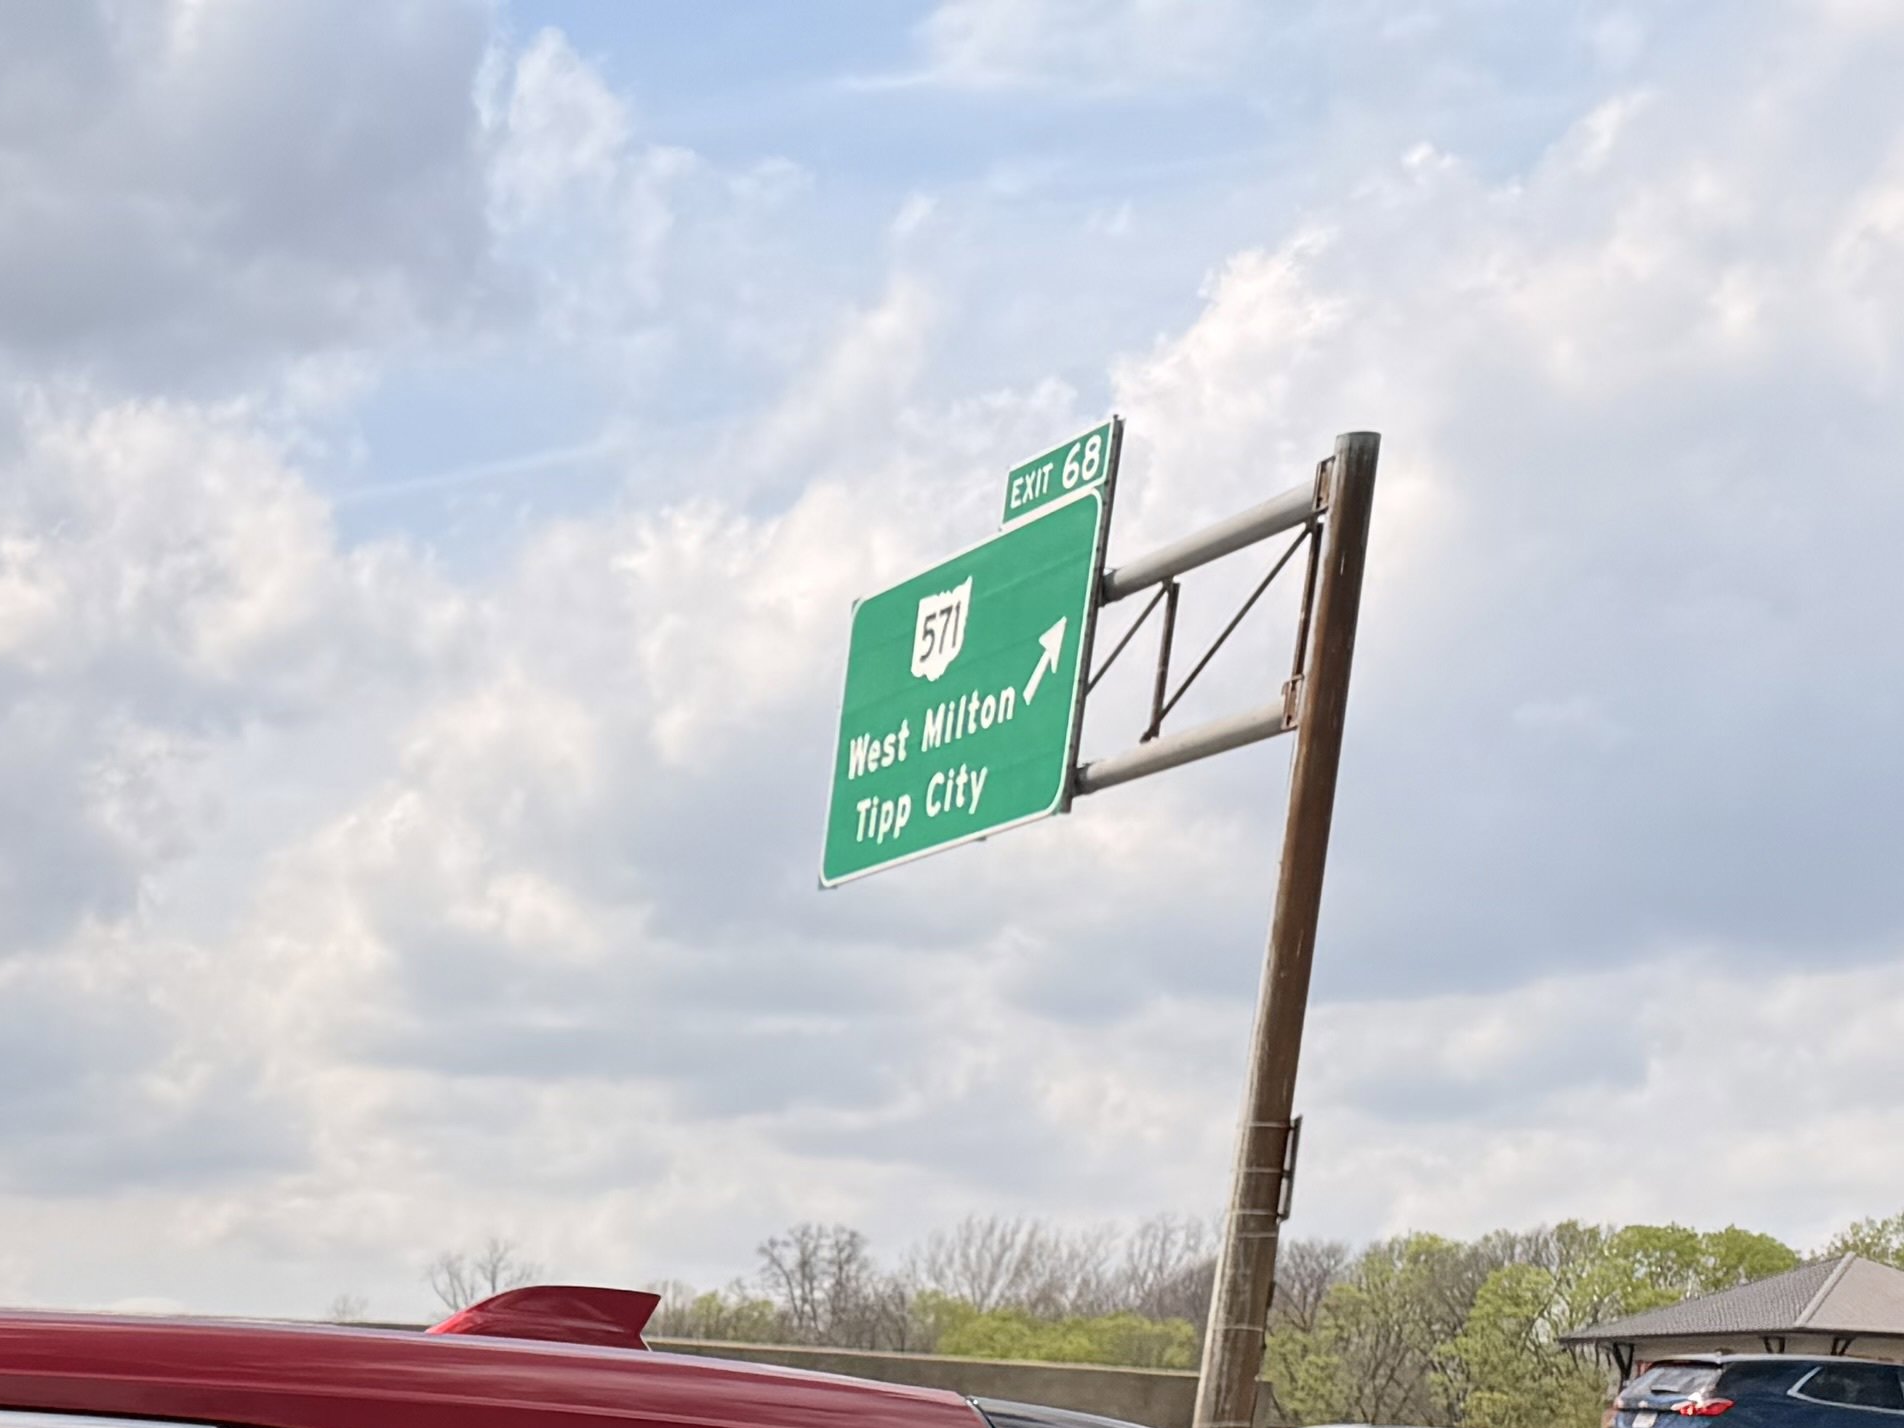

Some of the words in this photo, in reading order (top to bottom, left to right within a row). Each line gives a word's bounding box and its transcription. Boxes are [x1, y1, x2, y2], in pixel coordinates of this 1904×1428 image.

[1009, 463, 1053, 509] EXIT
[1062, 434, 1101, 490] 68
[919, 601, 962, 664] 571
[848, 719, 910, 780] West
[921, 686, 1016, 752] Milton
[856, 793, 912, 844] Tipp
[926, 764, 988, 817] City
